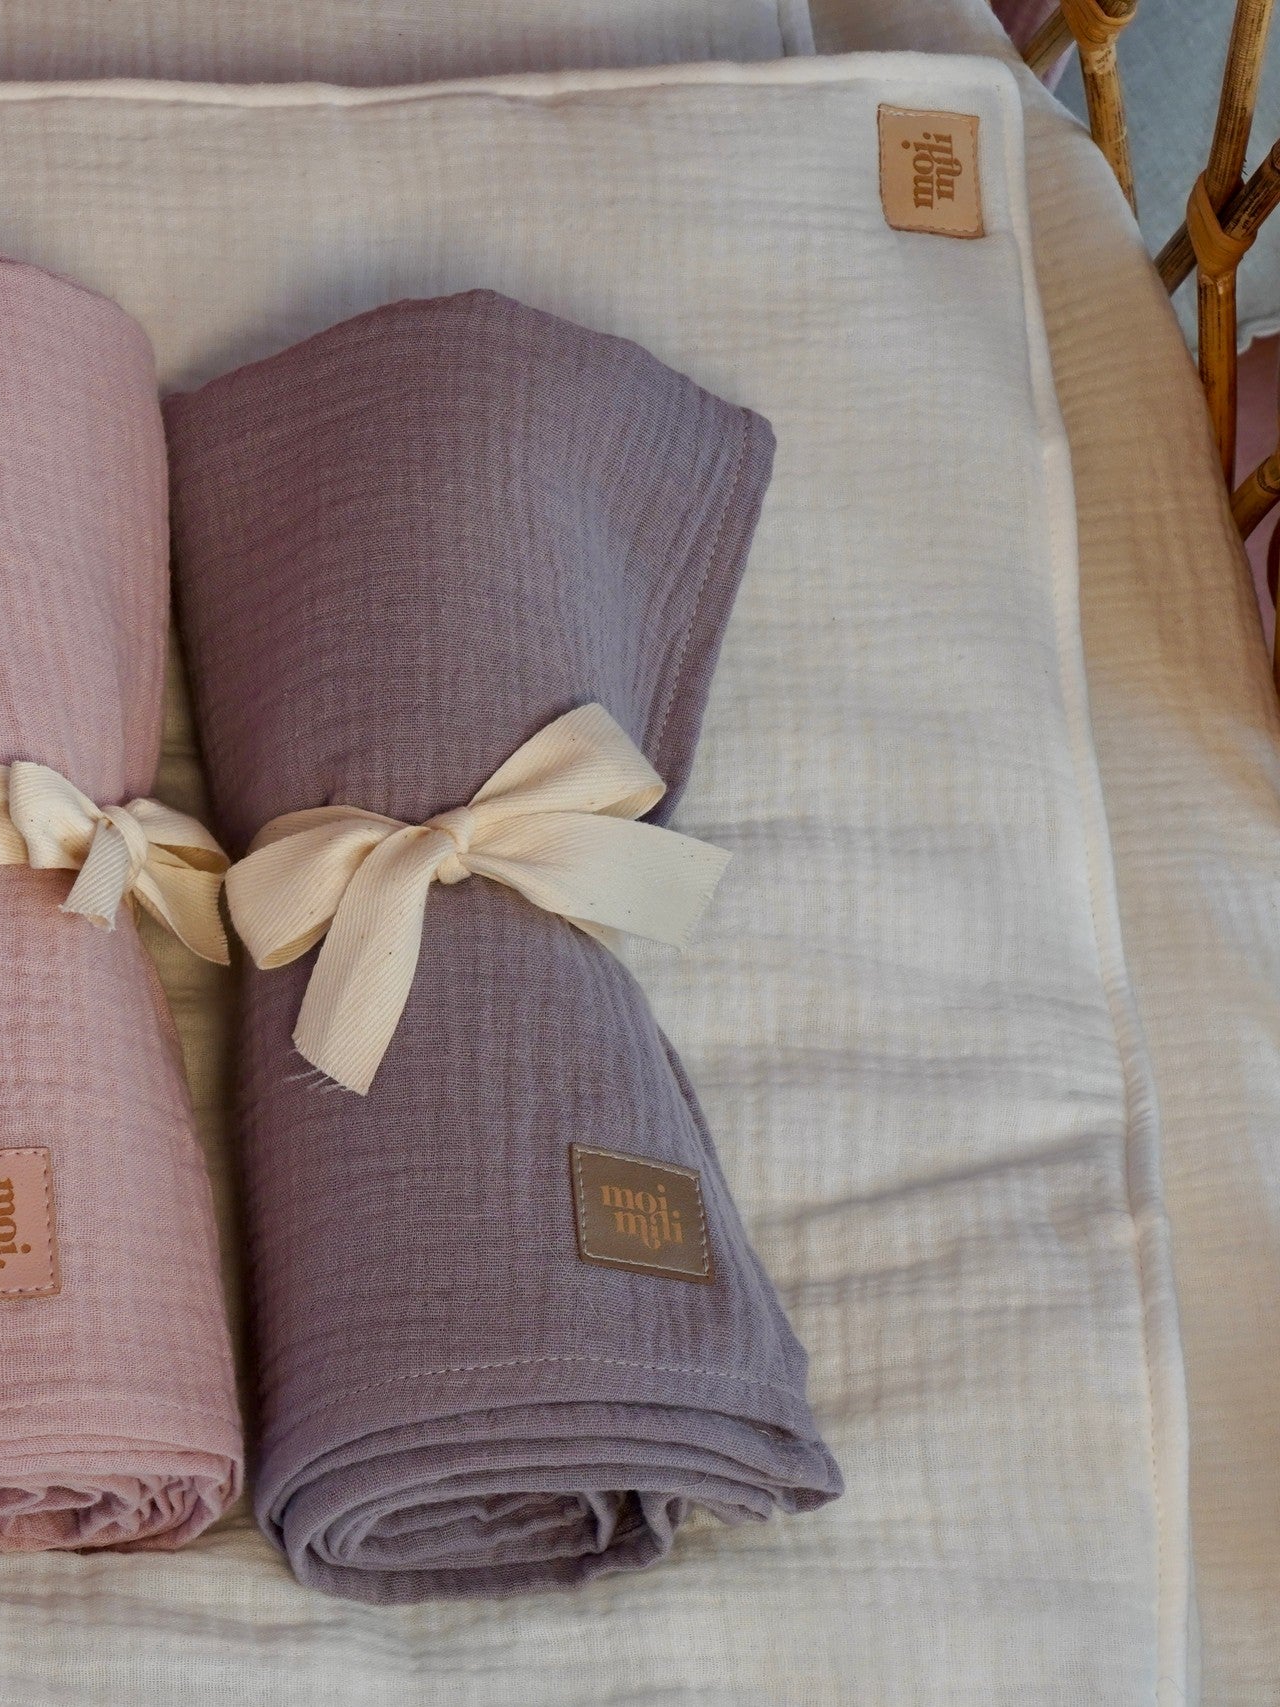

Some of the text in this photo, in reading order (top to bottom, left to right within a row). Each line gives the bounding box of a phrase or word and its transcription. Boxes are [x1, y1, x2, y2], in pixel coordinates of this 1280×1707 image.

[901, 140, 933, 209] moi
[922, 133, 962, 201] mili
[600, 1184, 668, 1213] moi
